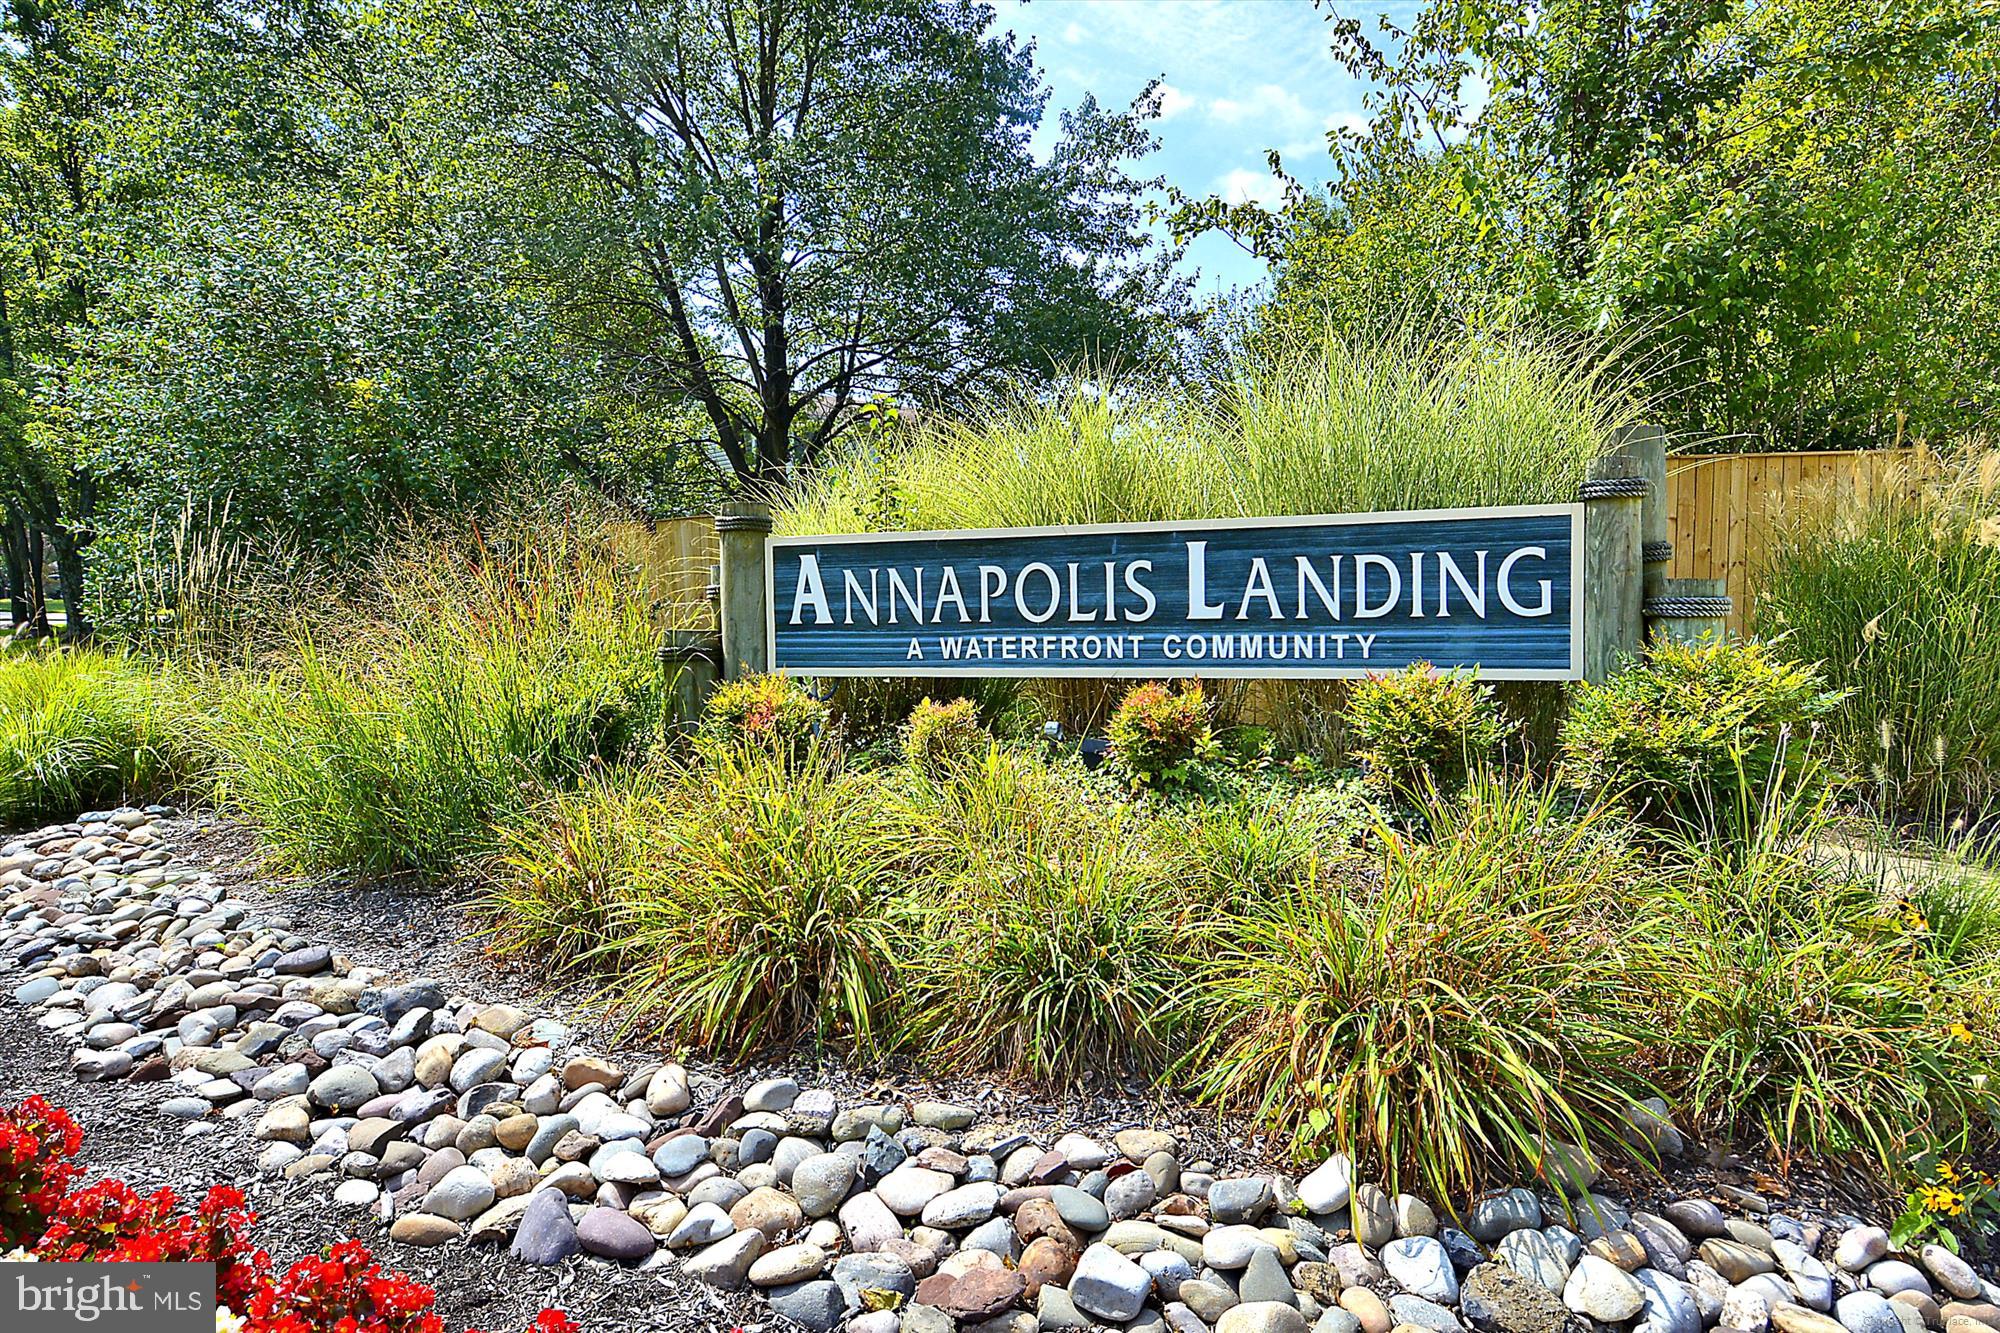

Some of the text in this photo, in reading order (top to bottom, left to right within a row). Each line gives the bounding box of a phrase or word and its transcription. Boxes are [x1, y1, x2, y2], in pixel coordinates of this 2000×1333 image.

[789, 540, 1552, 626] ANNAPOLIS LANDING
[907, 633, 1377, 660] A WATERFRONT COMMUNITY
